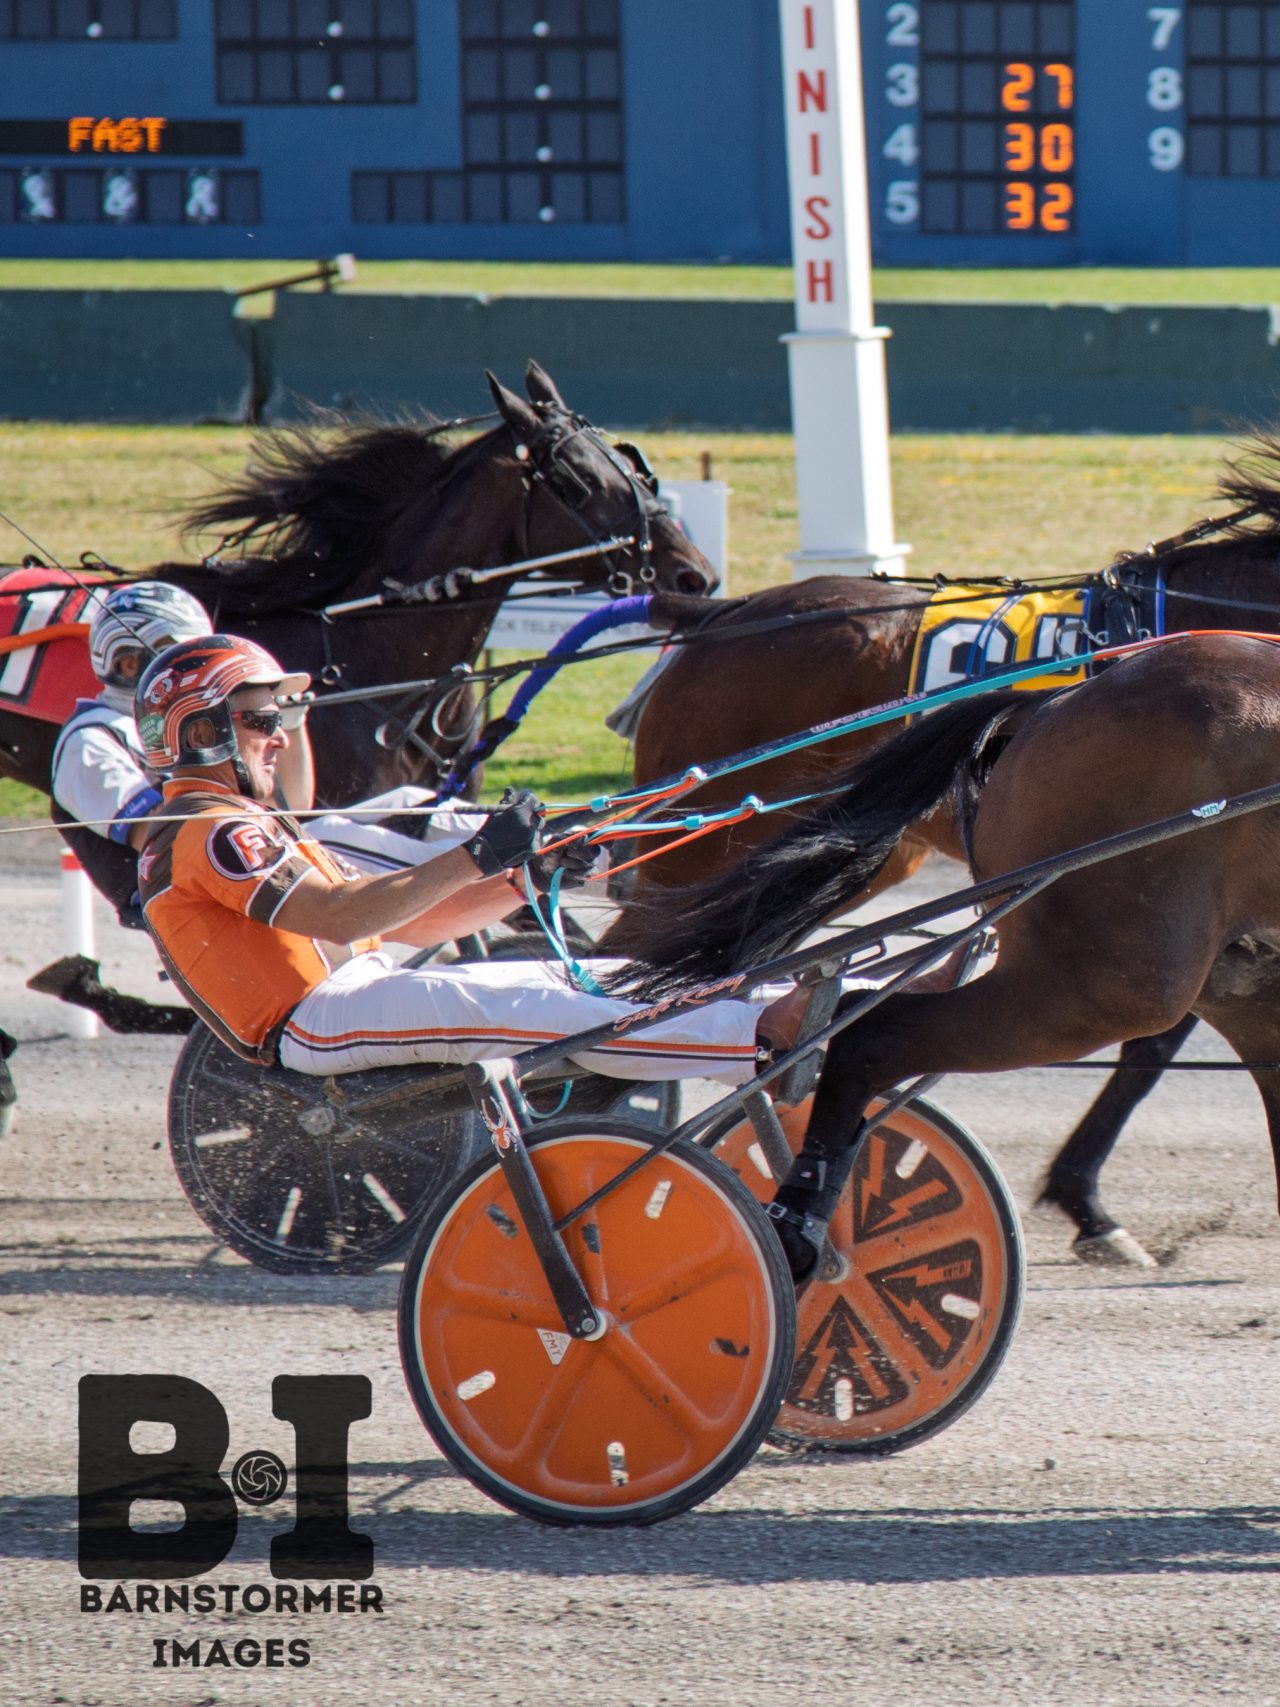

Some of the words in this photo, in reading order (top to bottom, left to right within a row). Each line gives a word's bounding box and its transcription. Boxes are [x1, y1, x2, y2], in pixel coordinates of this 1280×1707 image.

[886, 2, 919, 47] 2
[1147, 8, 1182, 50] 7
[885, 63, 919, 106] 3
[1002, 63, 1074, 112] 27
[1147, 67, 1183, 111] 8
[69, 117, 167, 152] FAST
[883, 124, 919, 166] 4
[1005, 123, 1074, 172] 30
[1148, 127, 1184, 171] 9
[885, 182, 919, 224] 5
[1005, 182, 1073, 232] 32
[543, 1332, 562, 1355] FMT
